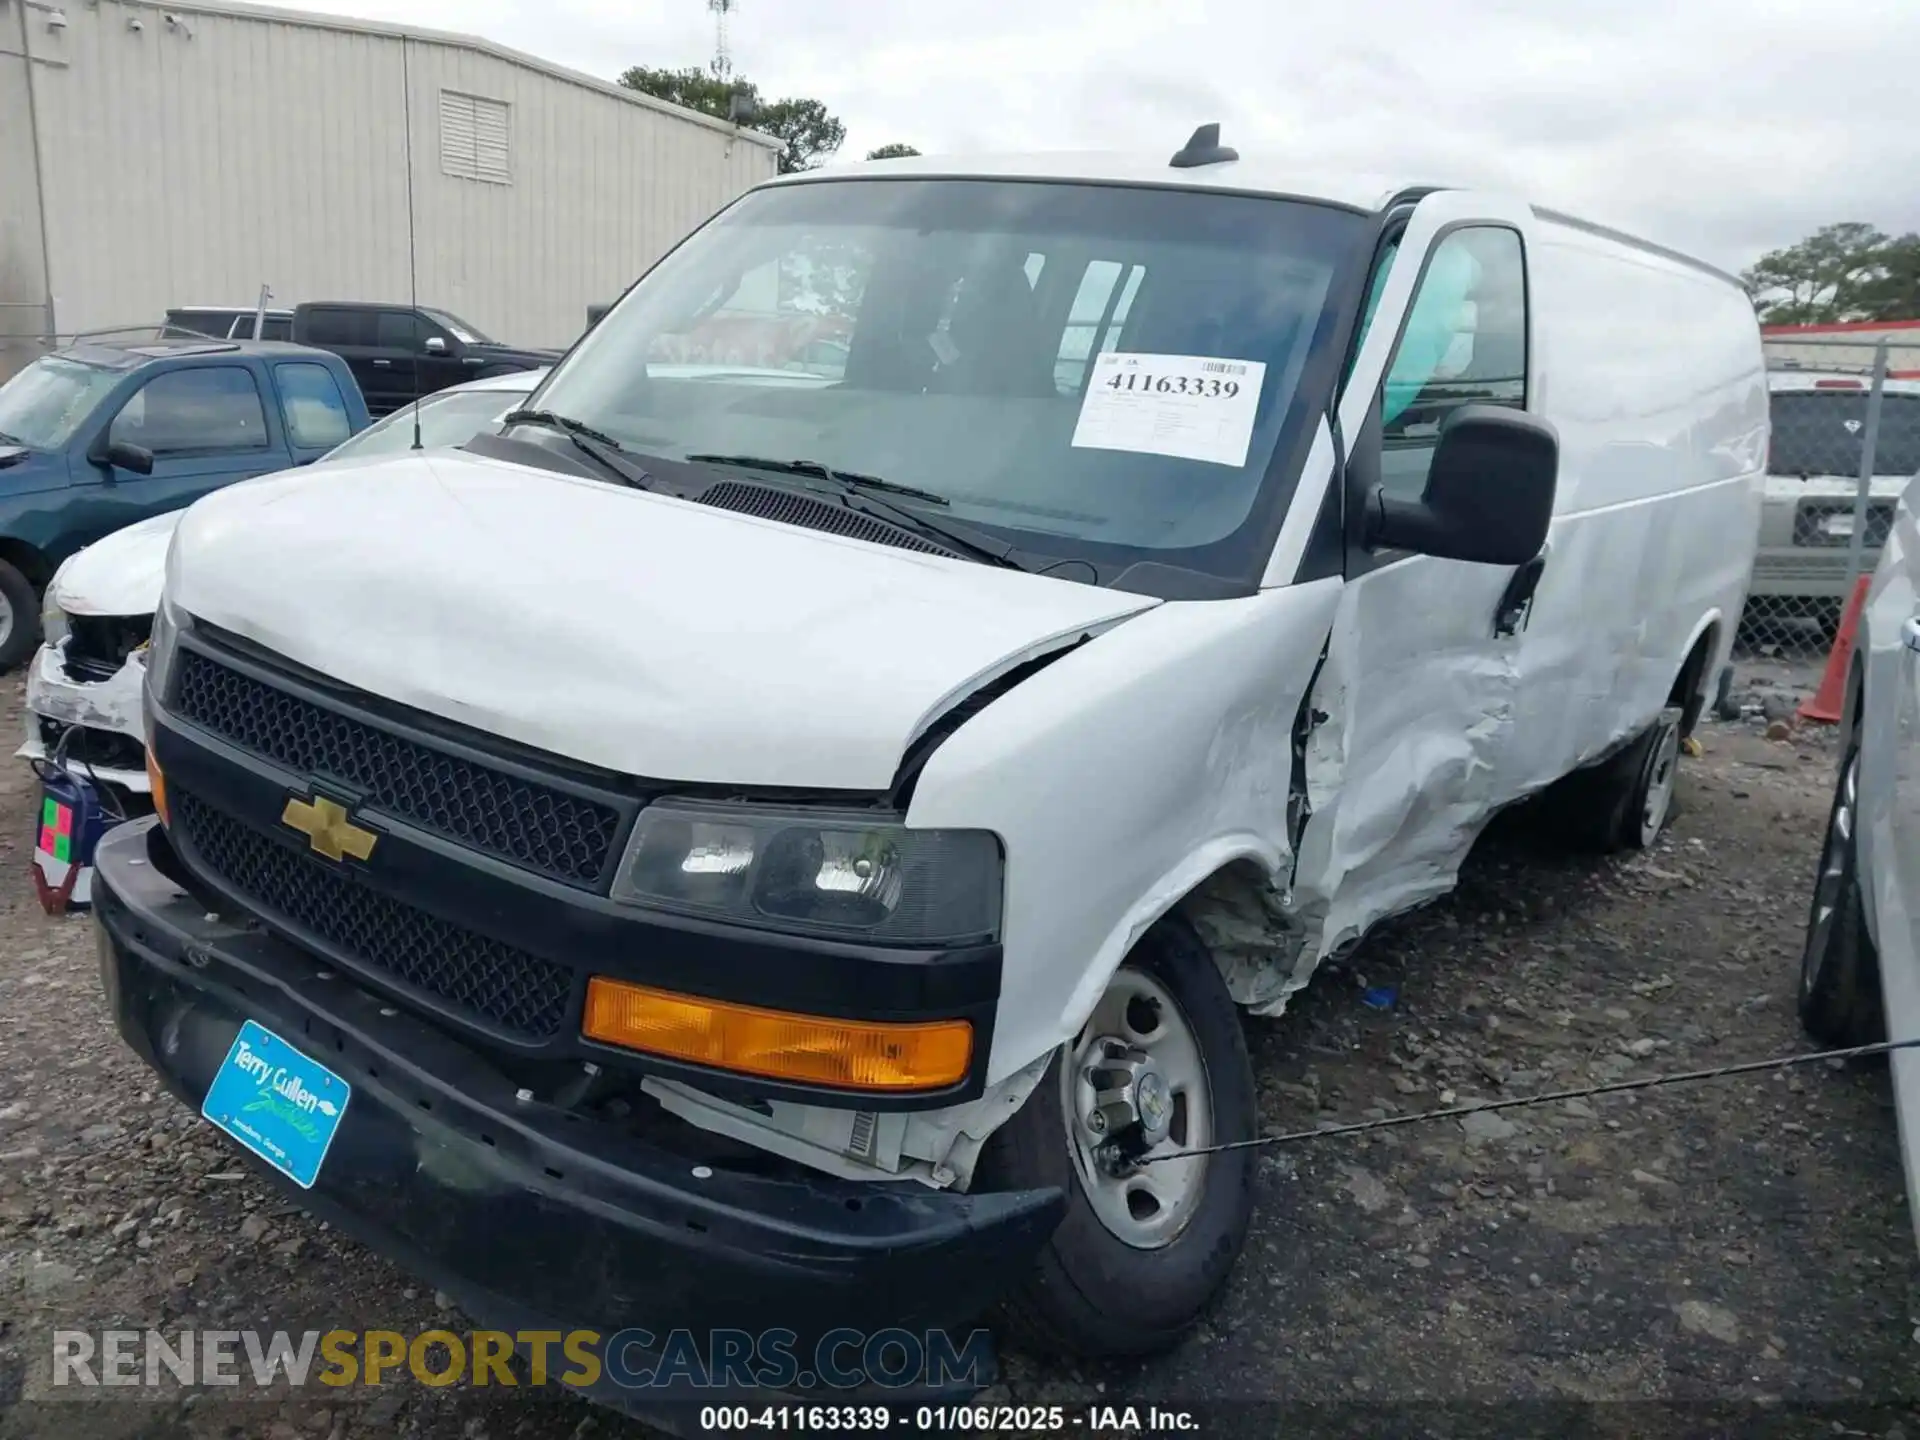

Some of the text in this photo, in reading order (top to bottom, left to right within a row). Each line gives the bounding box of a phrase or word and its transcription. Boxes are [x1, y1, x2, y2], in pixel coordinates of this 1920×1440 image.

[1107, 373, 1240, 399] 41163339
[234, 1040, 319, 1114] Terry Cullen
